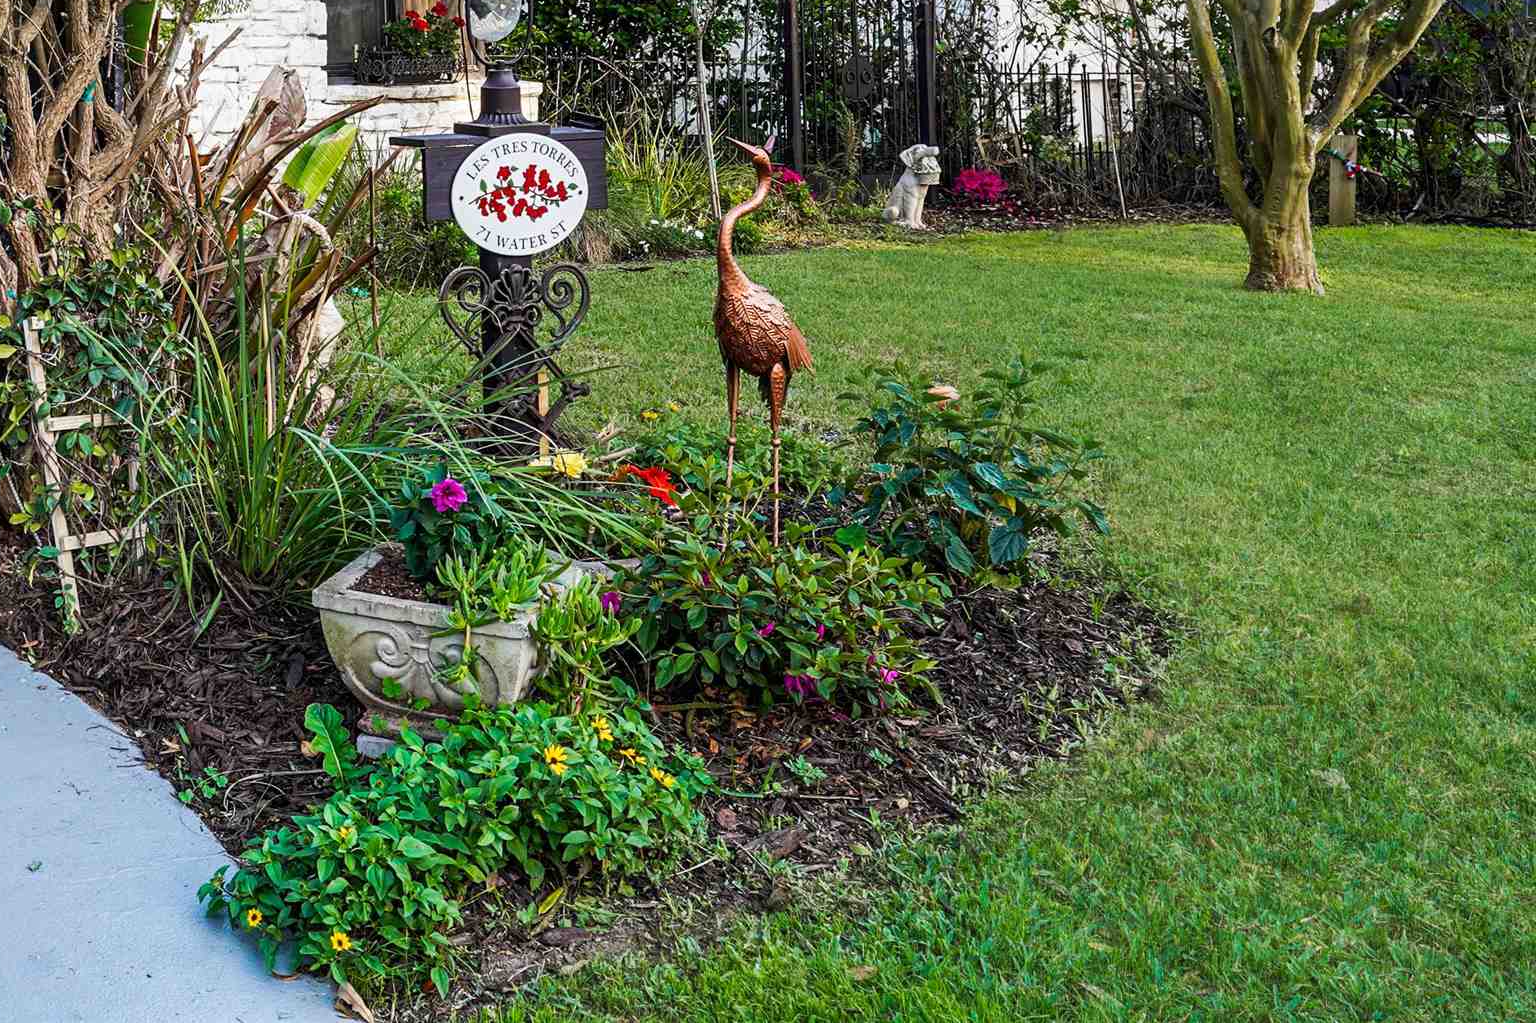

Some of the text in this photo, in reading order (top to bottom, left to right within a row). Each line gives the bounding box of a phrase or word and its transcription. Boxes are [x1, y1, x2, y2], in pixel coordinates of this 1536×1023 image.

[466, 141, 579, 181] LES TRES TORRES
[475, 220, 569, 250] 71 WATER ST
